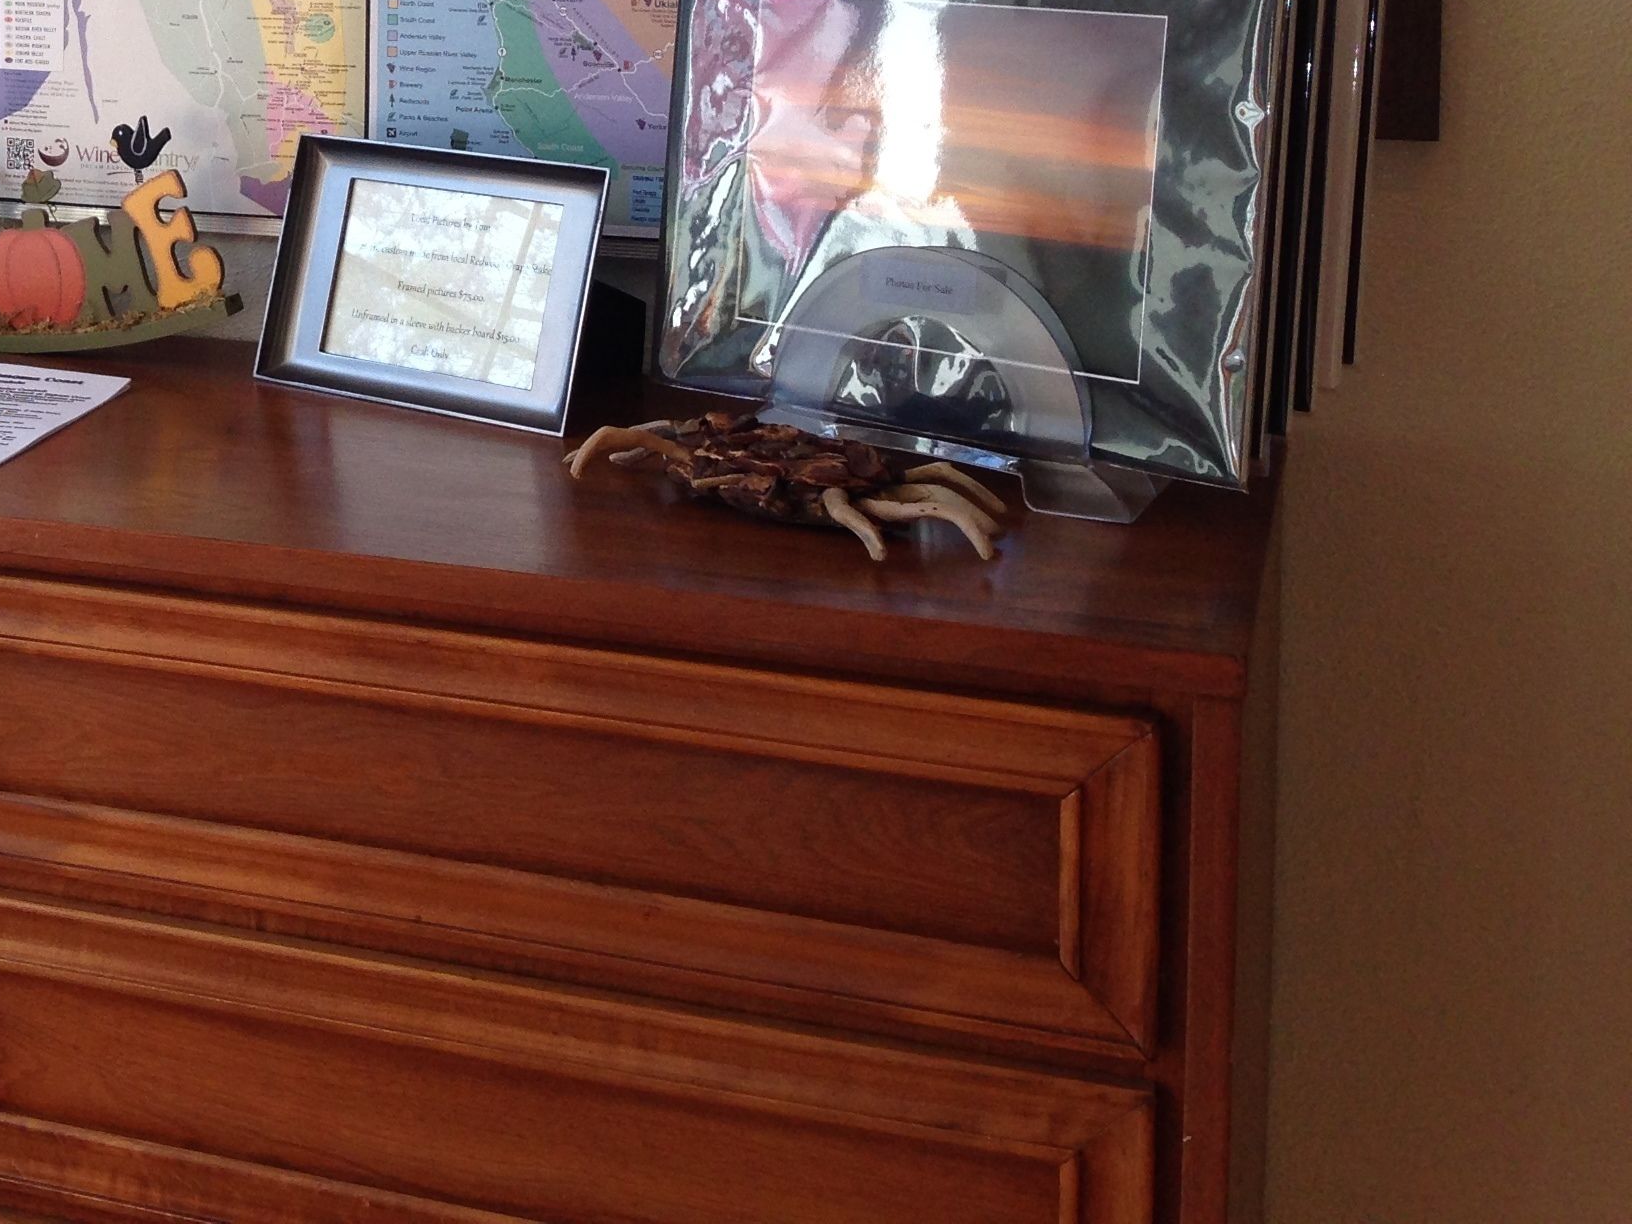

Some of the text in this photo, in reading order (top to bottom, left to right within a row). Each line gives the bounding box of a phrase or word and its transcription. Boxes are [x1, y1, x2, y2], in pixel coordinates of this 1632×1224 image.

[426, 283, 457, 300] pictures
[885, 276, 953, 295] Photos For Sale
[351, 307, 390, 324] Unframed
[406, 318, 428, 330] sleeve
[428, 320, 446, 334] with
[471, 327, 496, 342] board
